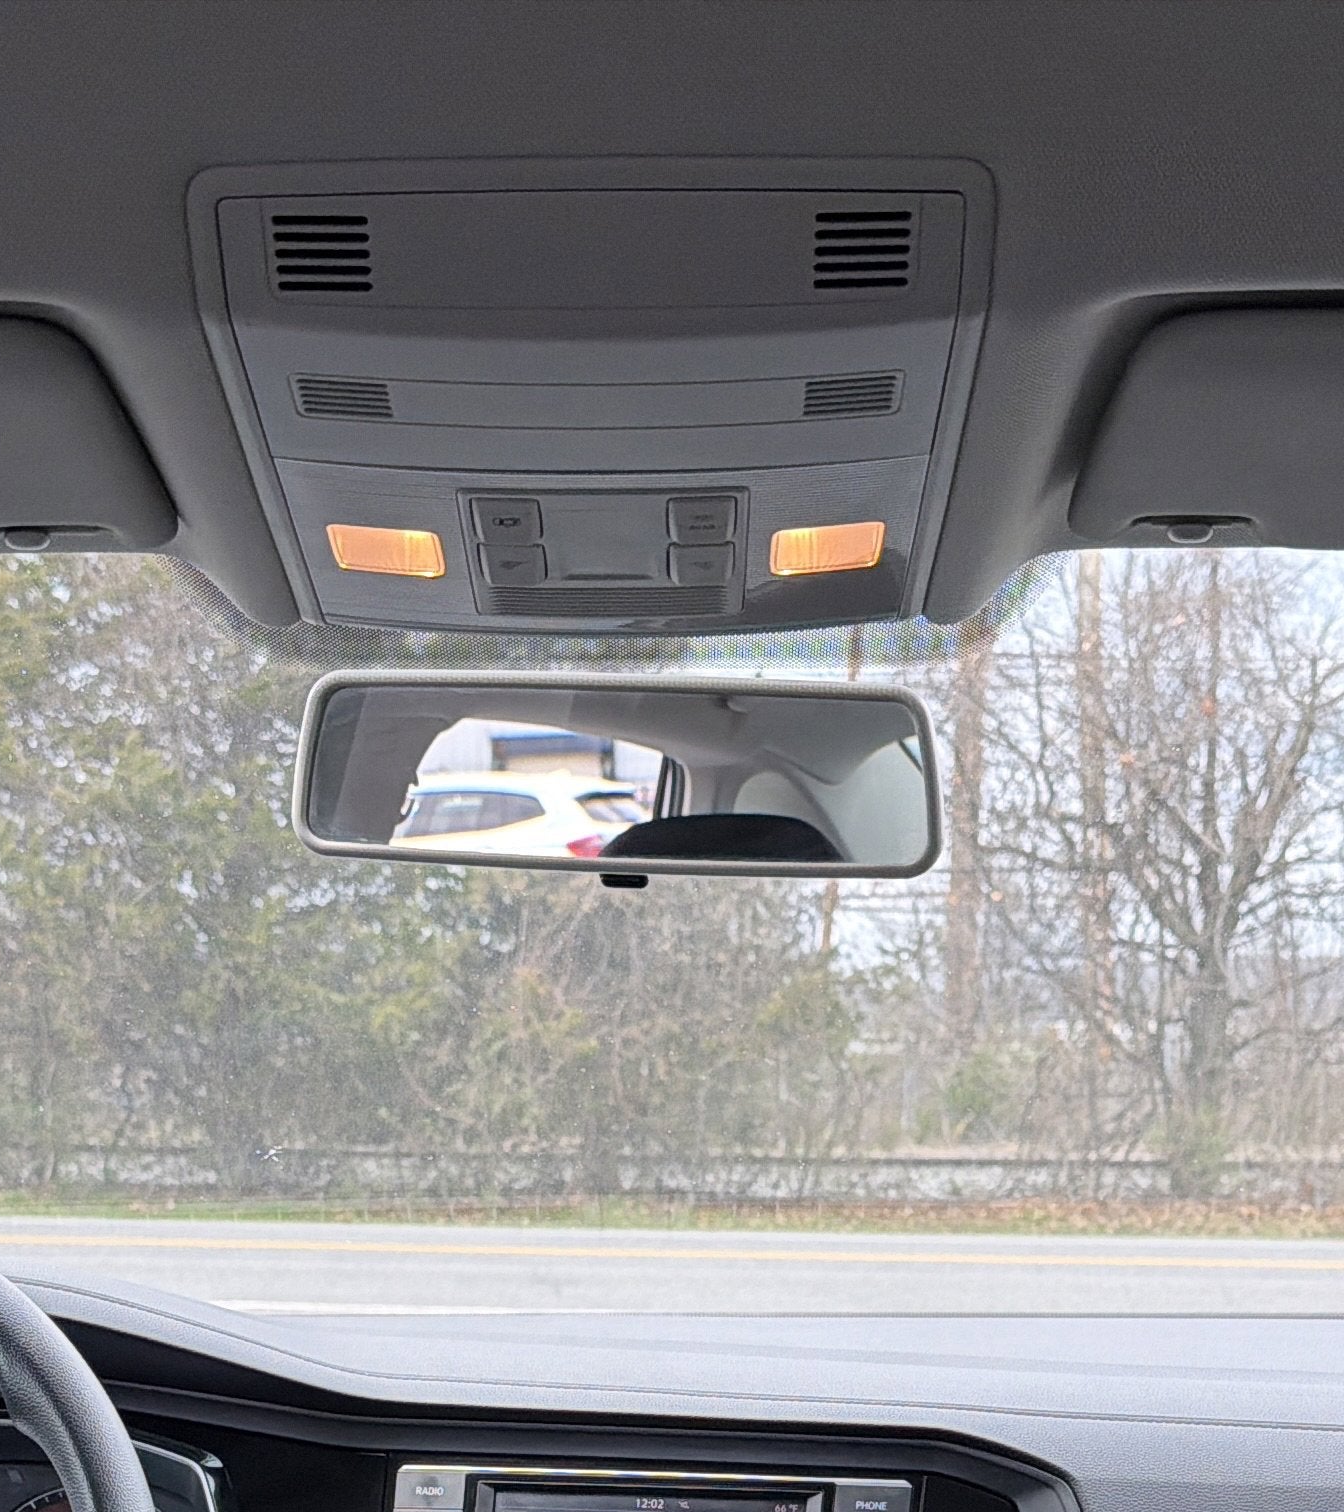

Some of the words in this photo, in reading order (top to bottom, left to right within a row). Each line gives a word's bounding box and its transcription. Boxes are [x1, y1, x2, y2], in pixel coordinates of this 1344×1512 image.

[415, 1485, 444, 1497] RADIO
[635, 1498, 665, 1510] 12:02
[774, 1503, 787, 1512] 66
[855, 1500, 888, 1511] PHONE
